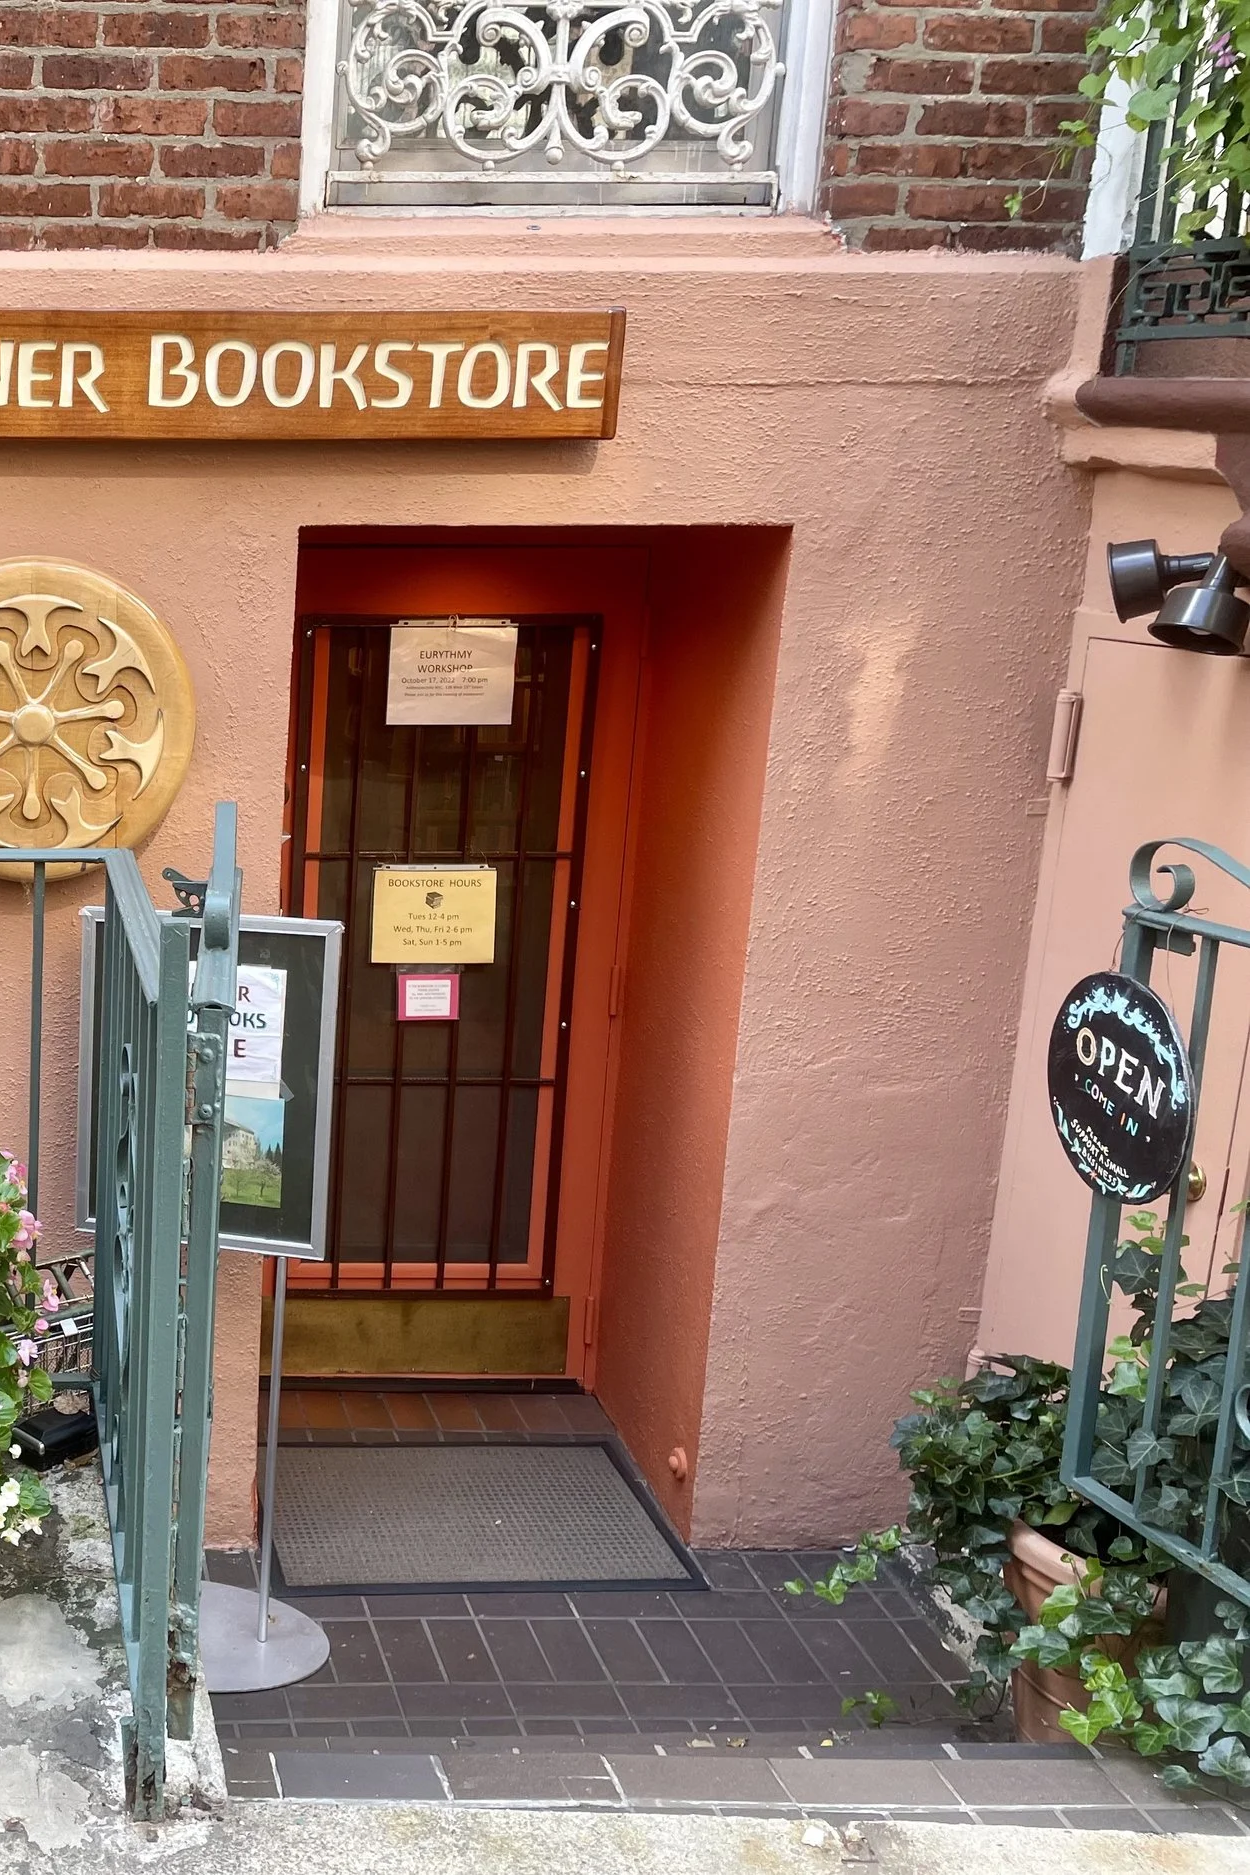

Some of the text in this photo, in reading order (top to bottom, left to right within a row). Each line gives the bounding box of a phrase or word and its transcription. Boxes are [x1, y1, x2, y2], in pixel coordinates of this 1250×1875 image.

[148, 333, 610, 411] BOOKSTORE
[417, 664, 473, 673] WORKSHOP
[419, 650, 473, 659] EURYTHMY
[388, 879, 482, 888] BOOKSTORE HOURS
[229, 1011, 267, 1029] OKS
[1076, 1027, 1166, 1120] OPEN
[1085, 1079, 1138, 1136] COME IN
[1070, 1119, 1129, 1179] SUPPORT A SMALL
[1082, 1147, 1117, 1186] BUSINESS
